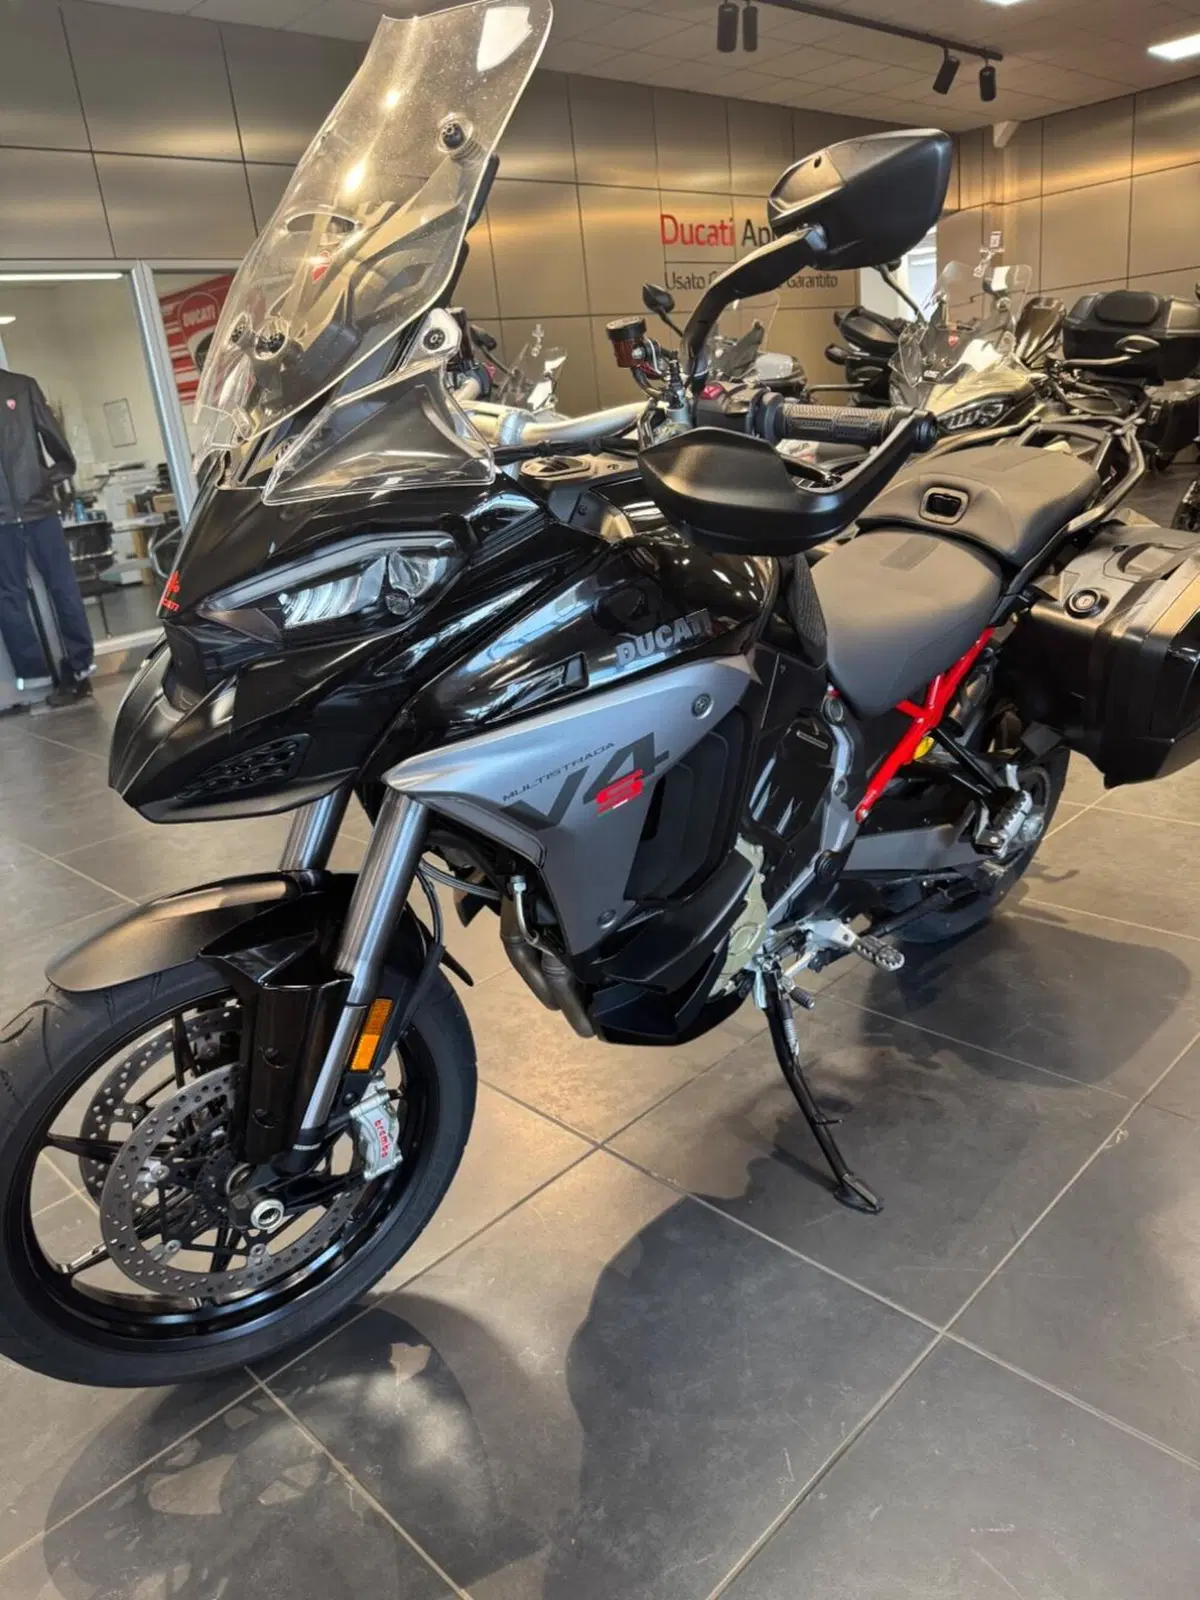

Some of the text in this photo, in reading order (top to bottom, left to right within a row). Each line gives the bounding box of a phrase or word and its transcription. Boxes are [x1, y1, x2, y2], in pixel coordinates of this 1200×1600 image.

[660, 213, 736, 247] Ducati
[664, 270, 706, 290] Usato
[182, 304, 217, 328] DUCATI
[615, 608, 712, 664] DUCATI
[502, 741, 615, 802] MULTISTRADA
[374, 1118, 390, 1159] brembo
